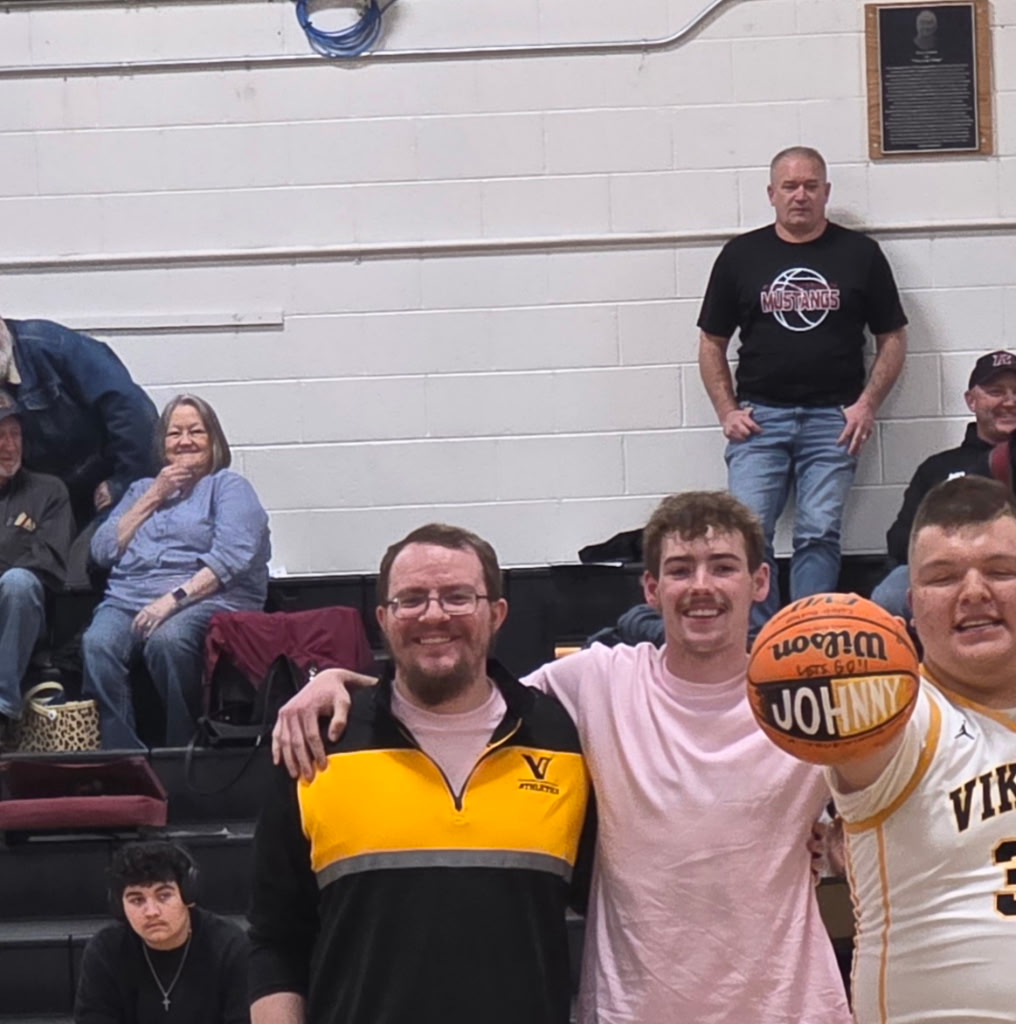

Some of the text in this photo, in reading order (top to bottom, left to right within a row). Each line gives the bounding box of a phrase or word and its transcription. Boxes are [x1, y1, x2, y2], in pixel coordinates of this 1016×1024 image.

[760, 289, 840, 313] MUSTANGS
[771, 630, 888, 662] Wilson
[771, 676, 901, 736] JOHNNY
